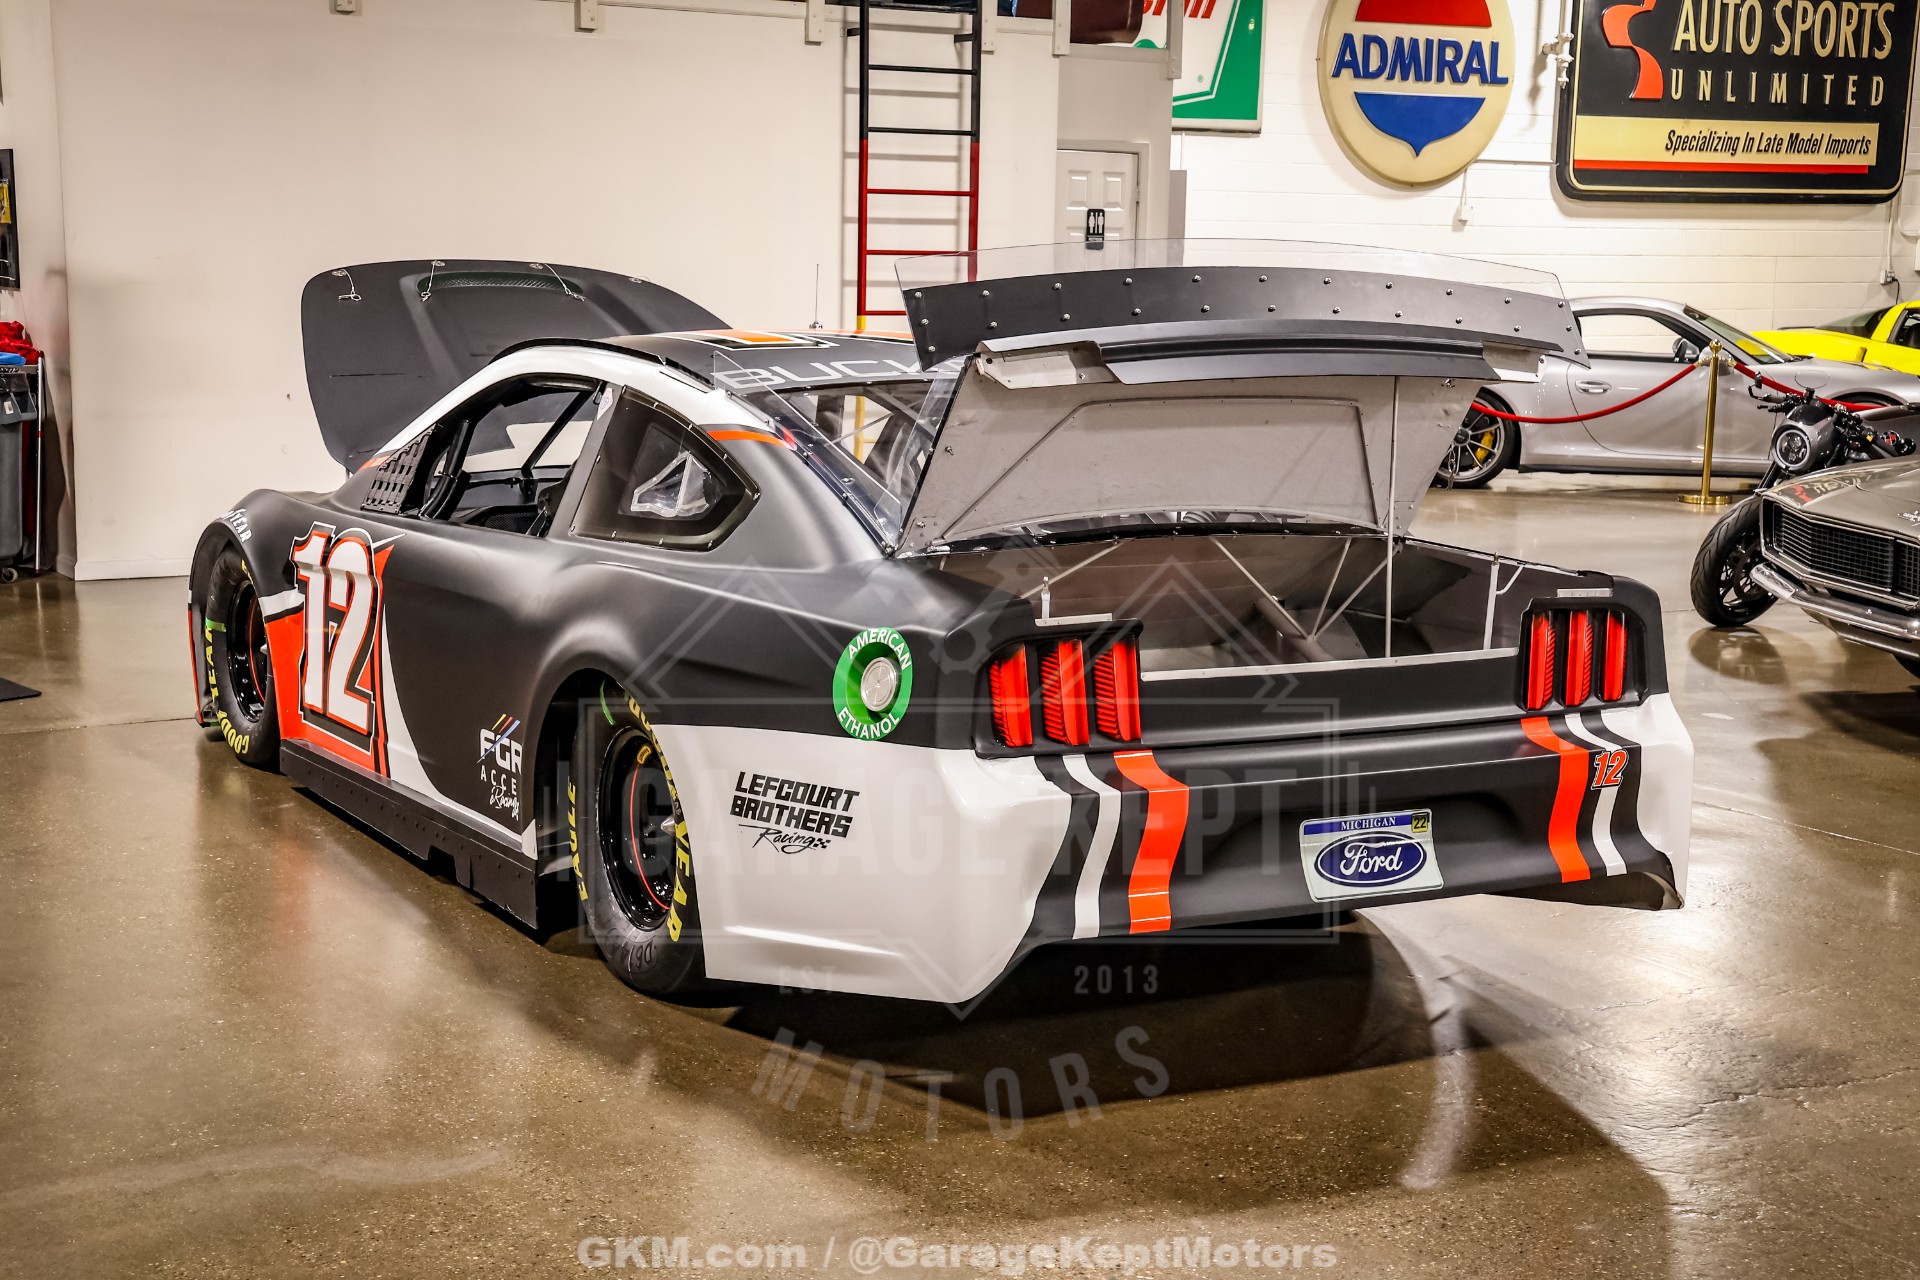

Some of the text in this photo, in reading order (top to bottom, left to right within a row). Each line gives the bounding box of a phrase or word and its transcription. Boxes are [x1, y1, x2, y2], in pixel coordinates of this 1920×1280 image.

[1674, 0, 1895, 60] AUTO SPORTS
[1332, 33, 1509, 85] ADMIRAL
[1671, 68, 1885, 107] UNLIMITED
[1665, 130, 1872, 158] Specializing In Late Model Imports
[290, 524, 376, 746] 12
[848, 628, 912, 671] AMERICAN
[837, 706, 901, 739] ETHANOL
[1592, 750, 1629, 790] 12
[735, 771, 861, 812] LEFCOURT
[730, 795, 854, 838] BROTHERS
[1340, 816, 1427, 831] MICHIGAN 22
[567, 775, 589, 901] EAGLE
[738, 823, 817, 855] Racing
[1340, 842, 1404, 876] Ford
